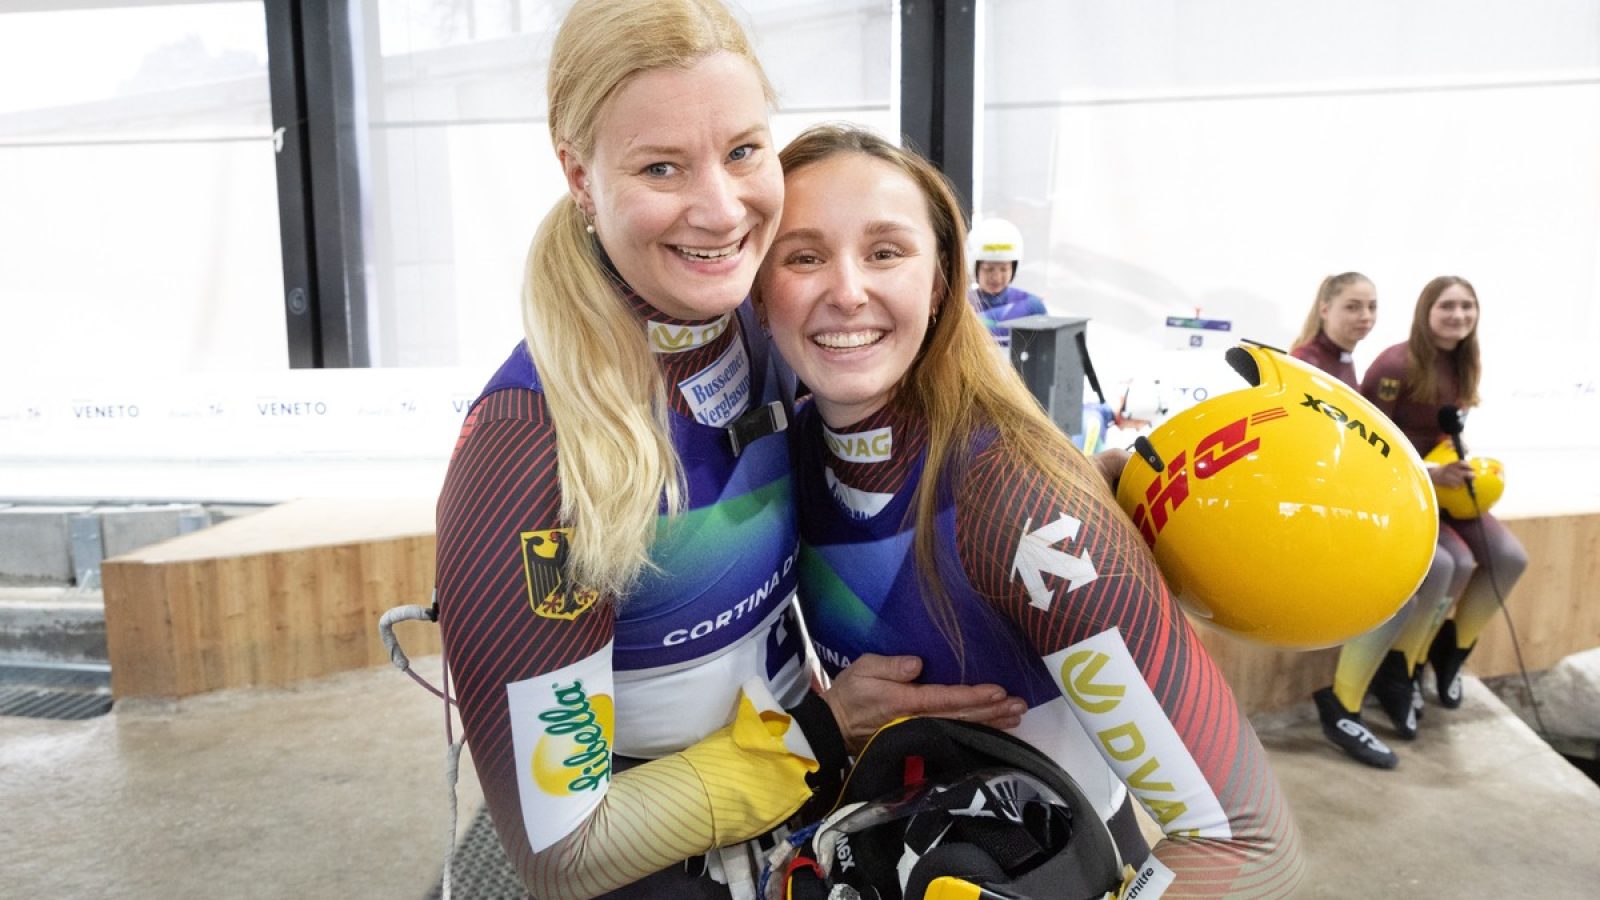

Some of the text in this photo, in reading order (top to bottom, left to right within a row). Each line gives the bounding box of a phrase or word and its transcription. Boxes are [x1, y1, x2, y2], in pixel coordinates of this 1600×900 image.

[72, 404, 140, 419] VENETO
[256, 401, 328, 416] VENETO
[1299, 393, 1391, 459] uvex
[662, 571, 780, 647] CORTINA
